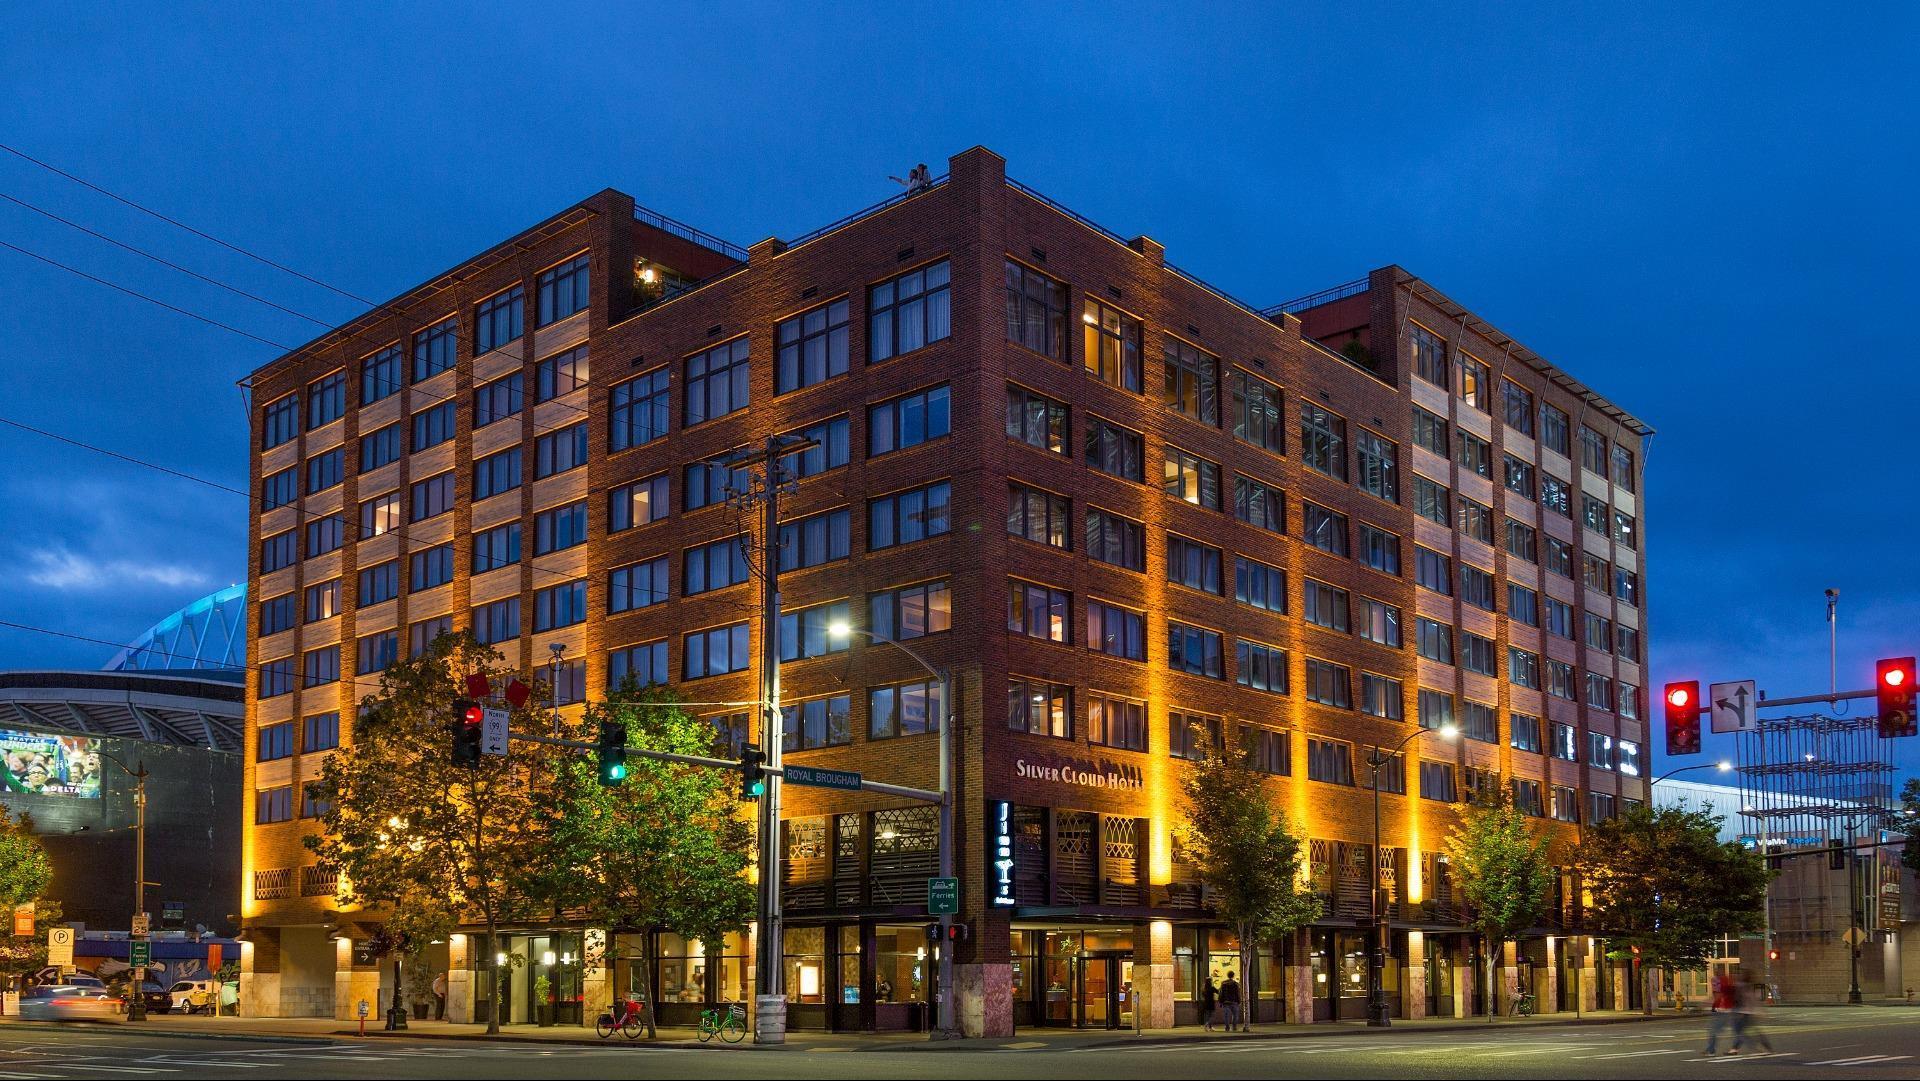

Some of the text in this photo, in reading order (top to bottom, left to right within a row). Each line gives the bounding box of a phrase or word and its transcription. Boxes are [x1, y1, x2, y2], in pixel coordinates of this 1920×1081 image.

[491, 722, 500, 730] 99
[787, 769, 859, 786] ROYAL BROUGHAM
[1016, 759, 1059, 782] SILVER
[1061, 766, 1106, 788] CLOUD
[50, 785, 81, 794] DELTA
[931, 892, 955, 900] Ferries
[133, 925, 147, 934] 25
